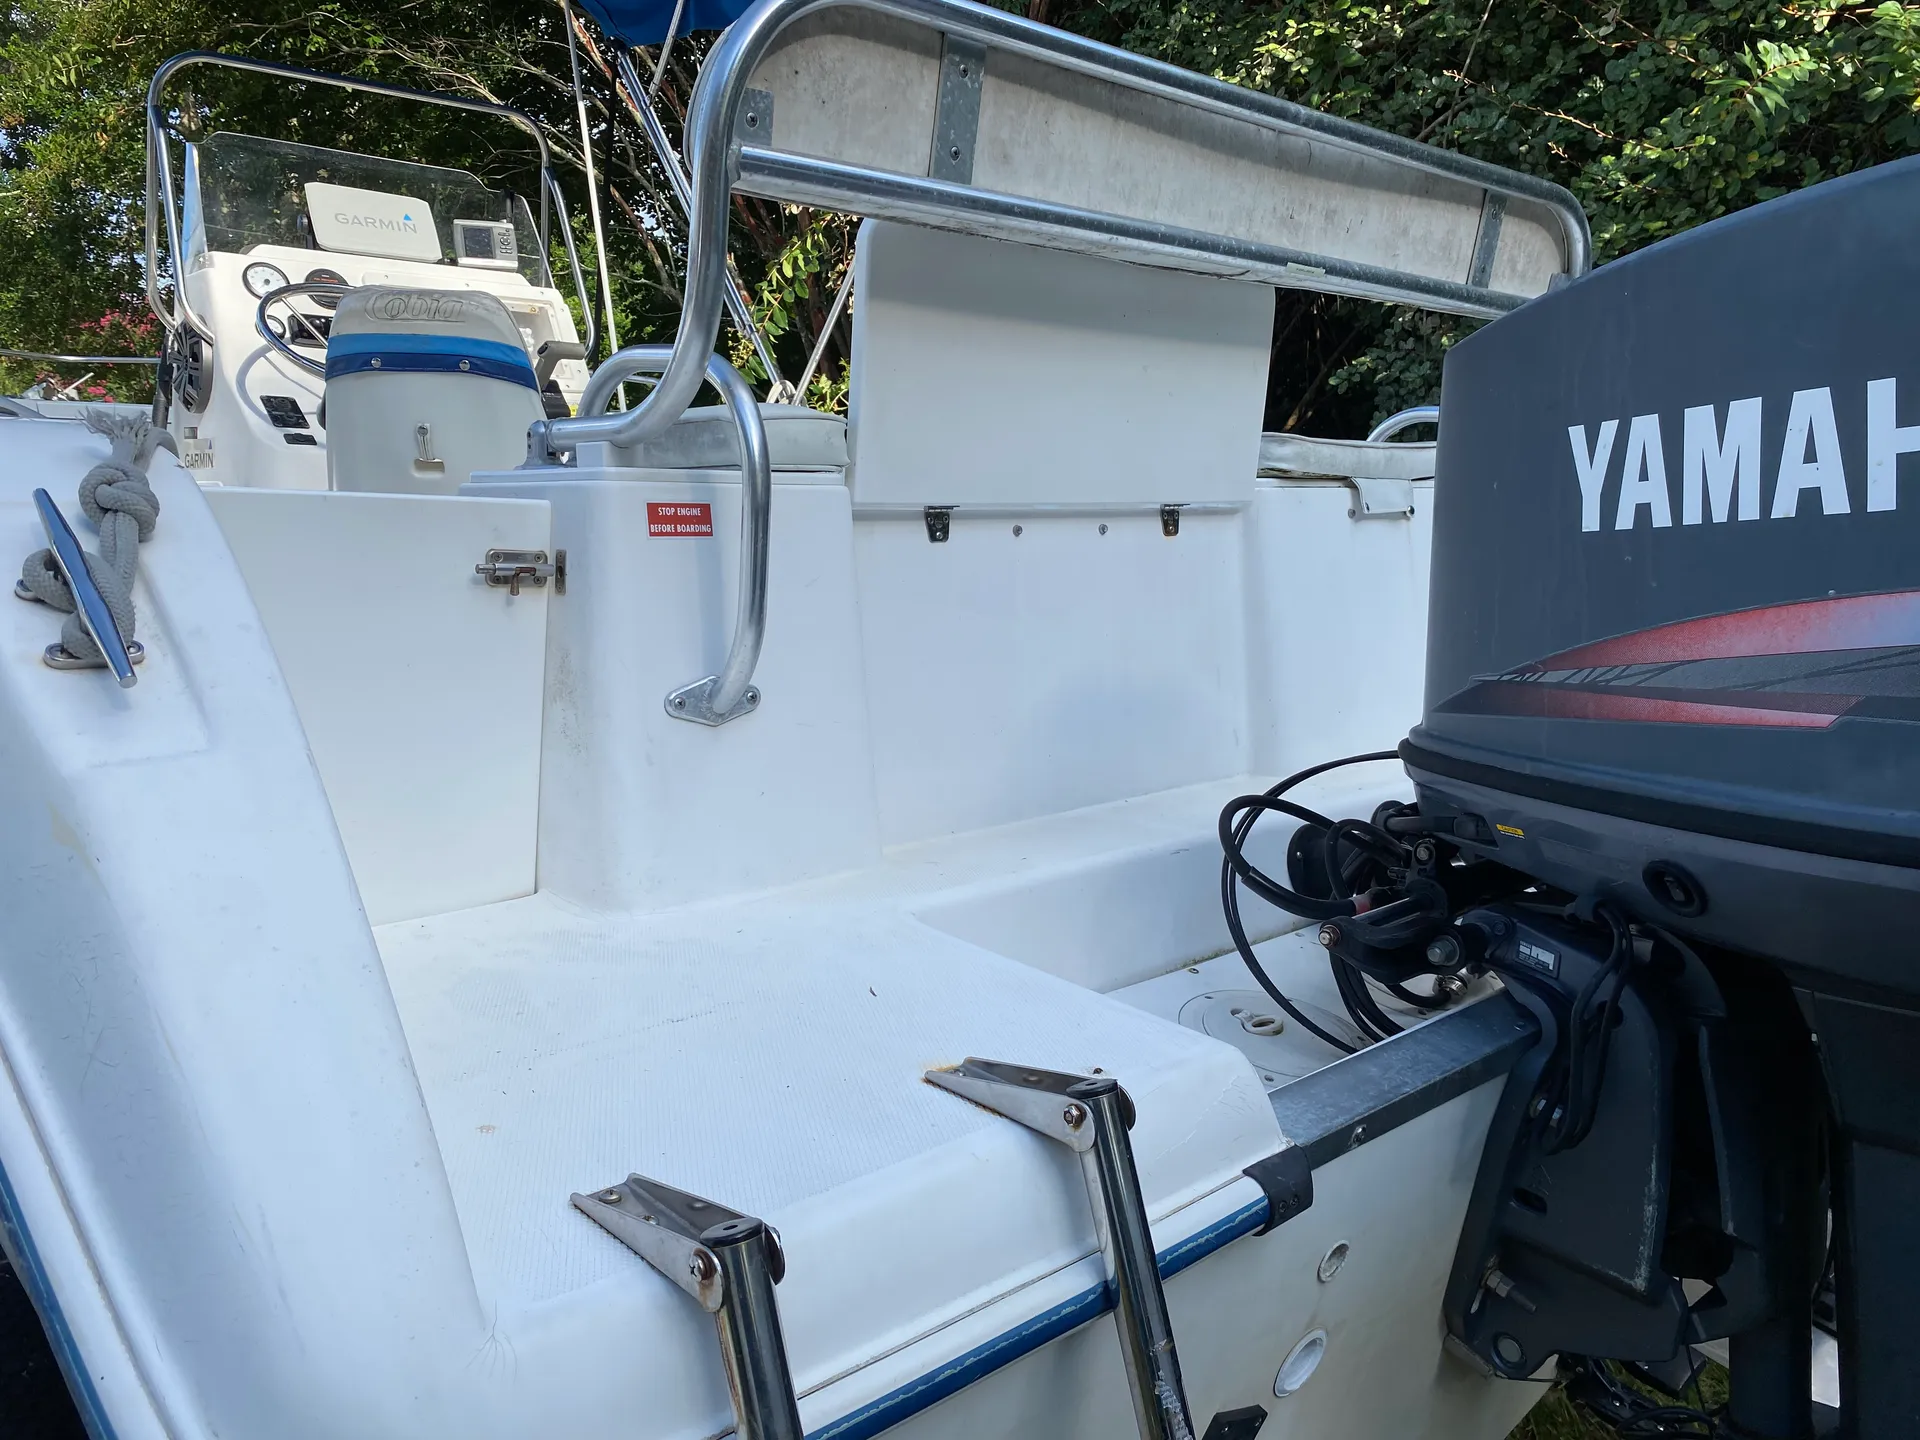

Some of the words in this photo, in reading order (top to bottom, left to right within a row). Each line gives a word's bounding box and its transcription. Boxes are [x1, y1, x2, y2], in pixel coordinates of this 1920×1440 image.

[334, 212, 418, 234] GARMIN
[184, 452, 214, 468] GARMIN
[657, 506, 675, 516] STOP
[677, 507, 702, 516] ENGINE
[650, 524, 675, 533] BEFORE
[676, 524, 712, 533] BOARDING
